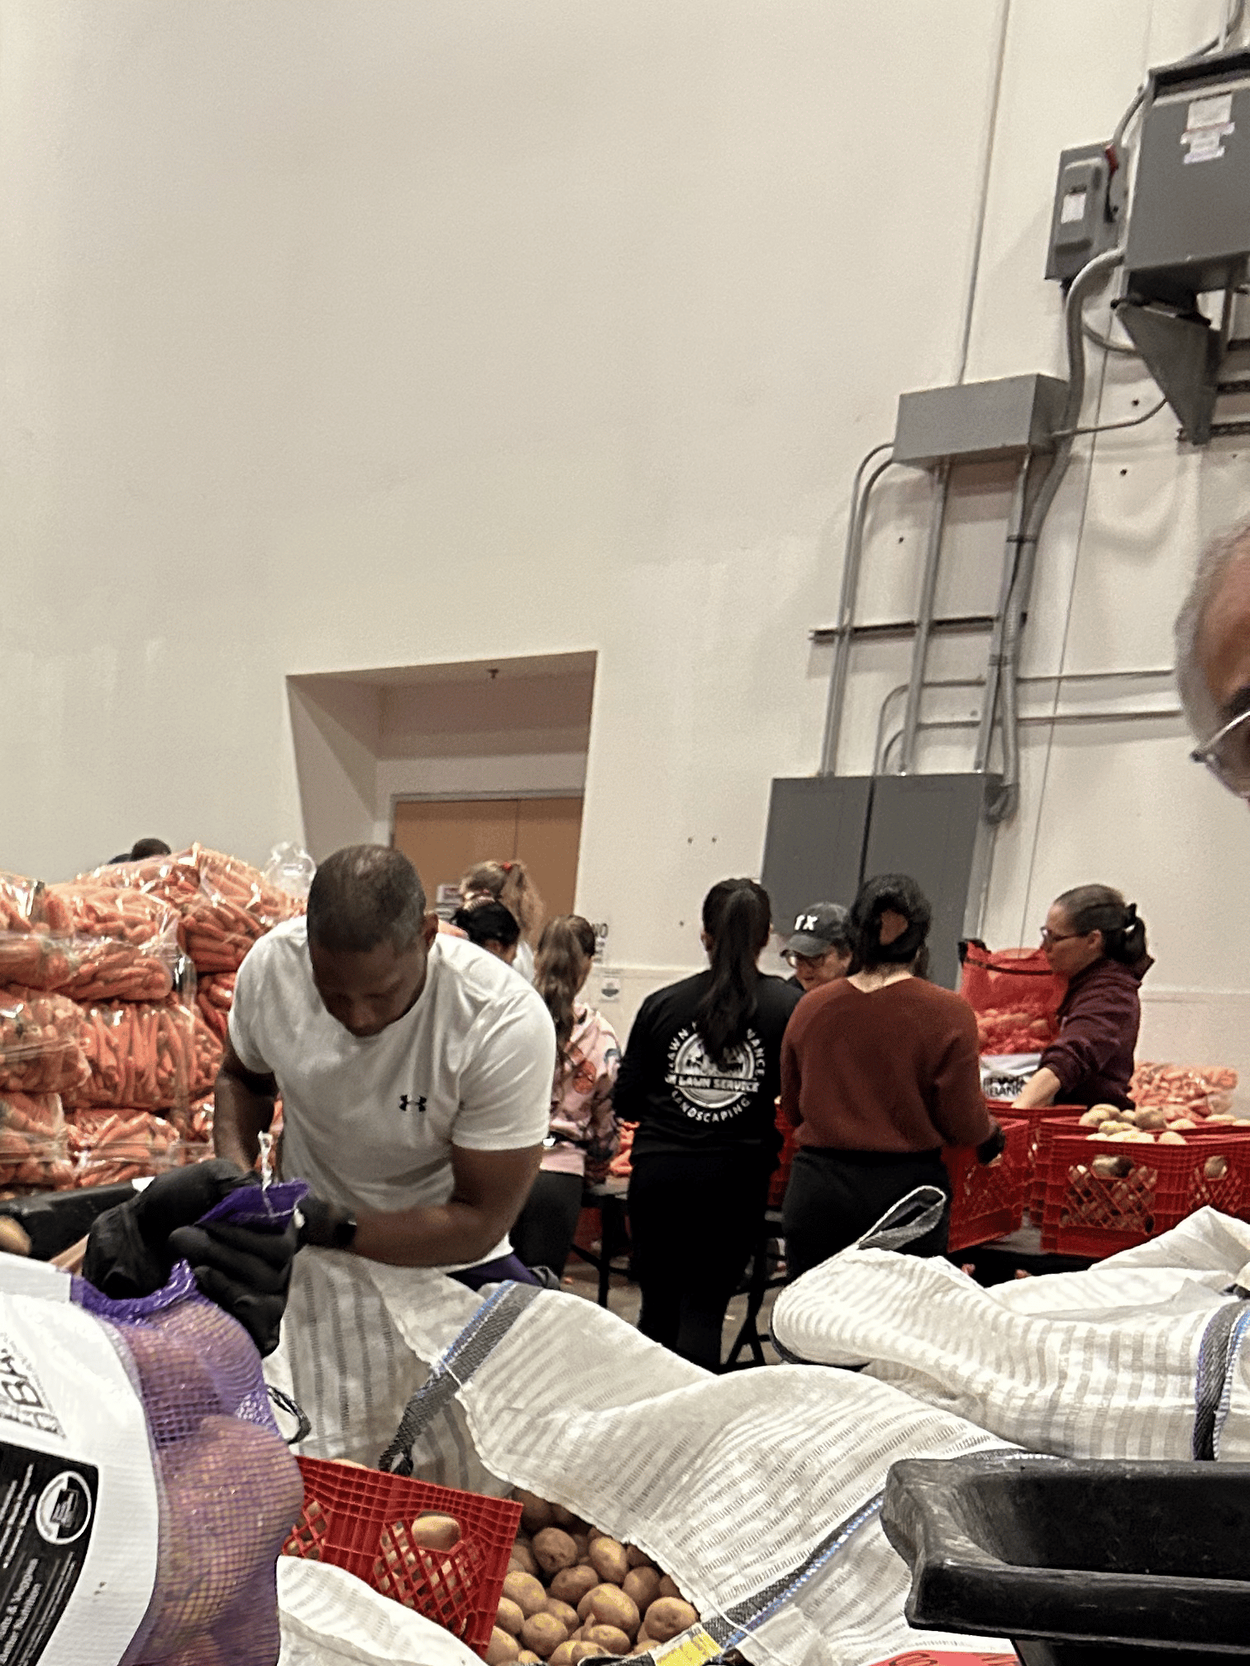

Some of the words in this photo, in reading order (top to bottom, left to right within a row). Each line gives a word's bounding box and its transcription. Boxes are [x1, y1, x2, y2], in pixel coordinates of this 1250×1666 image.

[678, 1076, 711, 1088] LAWN
[713, 1078, 760, 1093] SERVICE
[11, 1556, 40, 1604] Veggies
[13, 1581, 42, 1630] Nutrition
